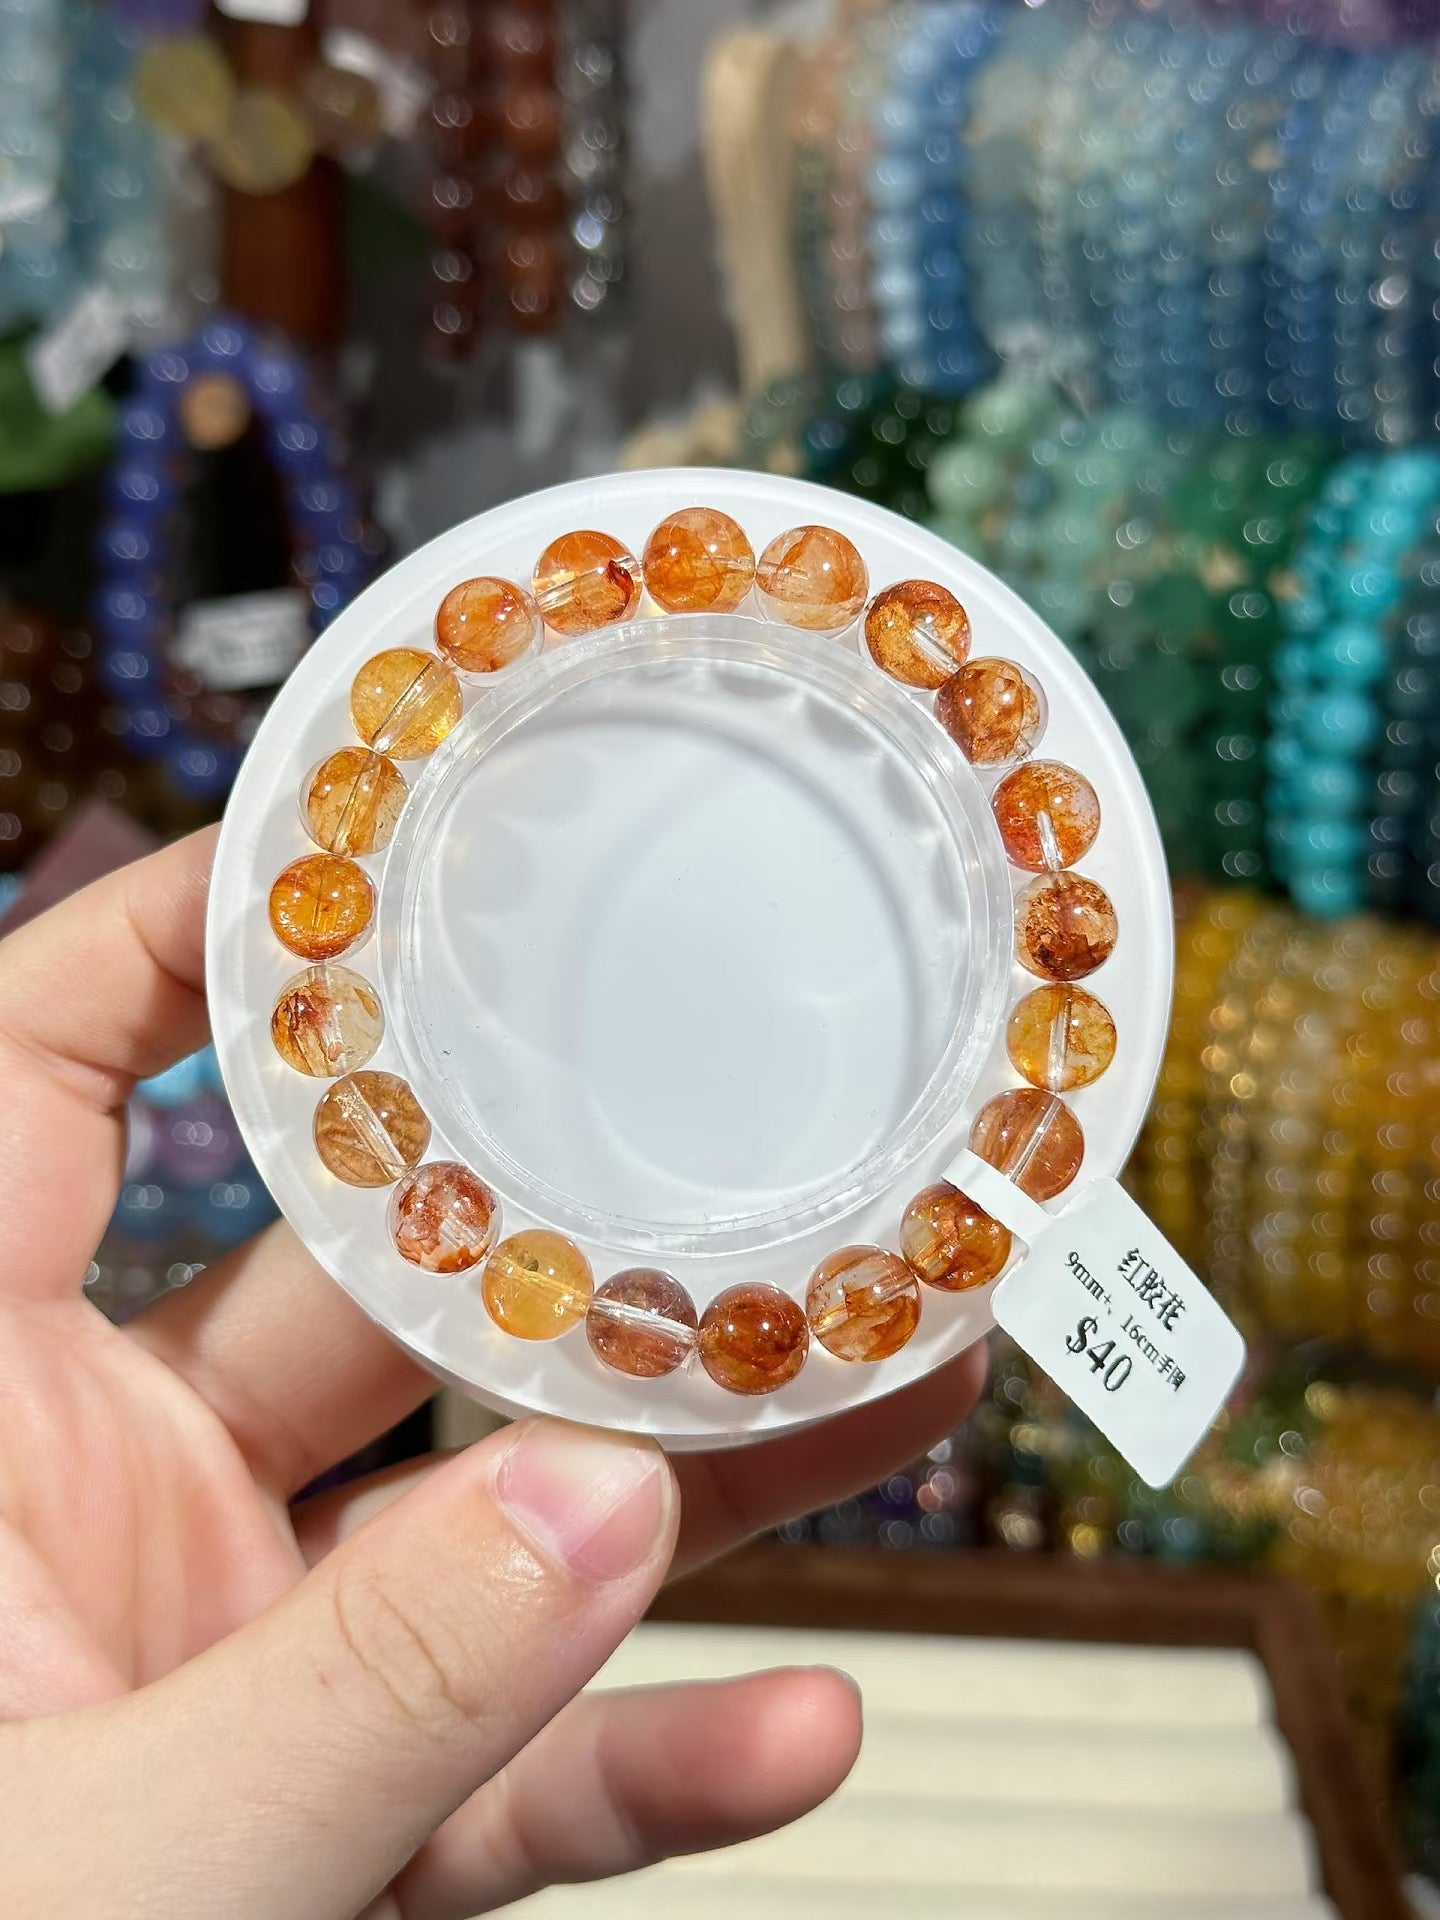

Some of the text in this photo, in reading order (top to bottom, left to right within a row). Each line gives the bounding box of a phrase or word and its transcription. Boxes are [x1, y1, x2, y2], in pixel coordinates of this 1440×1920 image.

[1117, 1248, 1186, 1331] 红胶花
[1066, 1316, 1132, 1392] $40
